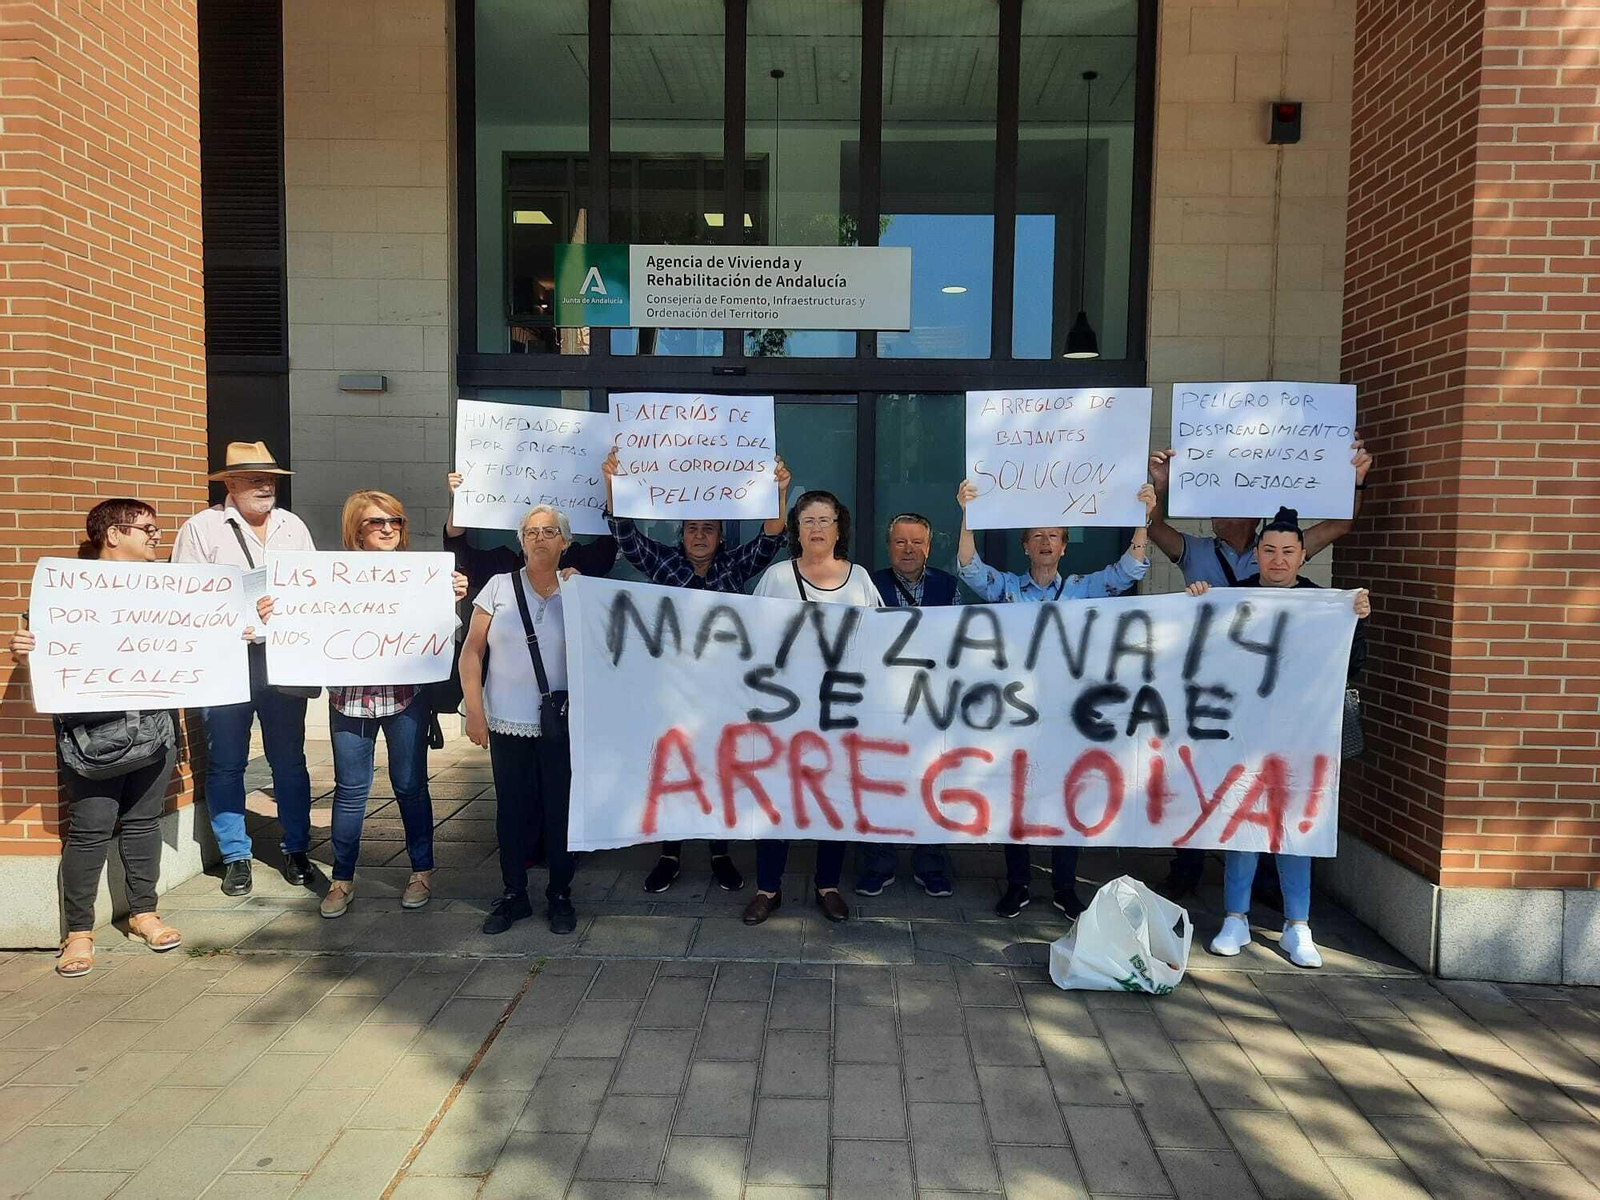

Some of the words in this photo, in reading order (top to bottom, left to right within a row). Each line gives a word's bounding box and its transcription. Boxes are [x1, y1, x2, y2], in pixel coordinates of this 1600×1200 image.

[646, 255, 702, 270] Agencia
[707, 255, 724, 268] de
[728, 255, 790, 269] Vivienda
[794, 259, 802, 272] y
[647, 272, 751, 287] Rehabilitación
[755, 274, 772, 287] de
[776, 273, 847, 288] Andalucía
[646, 294, 702, 306] Consejería
[705, 295, 718, 305] de
[720, 295, 770, 307] Fomento,
[773, 295, 857, 306] Infraestructuras
[859, 298, 866, 308] y
[646, 307, 708, 318] Ordenación
[710, 308, 726, 318] del
[729, 308, 779, 319] Territorio
[616, 396, 719, 423] BATERÍAS
[729, 408, 752, 423] DE
[981, 396, 1074, 416] ARREGLOS
[1089, 395, 1116, 409] DE
[1182, 391, 1269, 411] PELIGRO
[1281, 391, 1318, 411] POR
[464, 412, 583, 434] HUMEDADES
[1179, 422, 1350, 438] DESPRENDIMIENTO
[614, 432, 728, 449] CONTADORES
[737, 435, 770, 449] DEL
[995, 429, 1085, 446] BAJANTES
[469, 438, 504, 451] POR
[516, 440, 588, 457] GRIETAS
[1187, 448, 1215, 461] DE
[1229, 447, 1326, 462] CORNISAS
[466, 460, 477, 476] Y
[486, 462, 559, 481] FISURAS
[572, 474, 600, 486] EN
[613, 459, 659, 476] AGUA
[669, 458, 766, 473] CORROIDAS
[1179, 471, 1221, 490] POR
[1235, 472, 1322, 490] DEJADEZ
[461, 489, 507, 505] TODA
[513, 493, 532, 506] LA
[45, 567, 232, 594] INSALUBRIDAD
[274, 560, 317, 587] LAS
[424, 566, 440, 585] Y
[49, 606, 100, 625] POR
[110, 602, 239, 628] INUNDACIÓN
[271, 597, 400, 615] CUCARACHAS
[48, 641, 82, 656] DE
[117, 636, 198, 653] AGUAS
[272, 630, 311, 646] NOS
[323, 629, 449, 660] COMEN
[606, 589, 1155, 683] MANZANA
[1181, 601, 1290, 698] 14
[54, 667, 205, 689] FECALES
[743, 664, 866, 731] SE
[903, 669, 1039, 731] NOS
